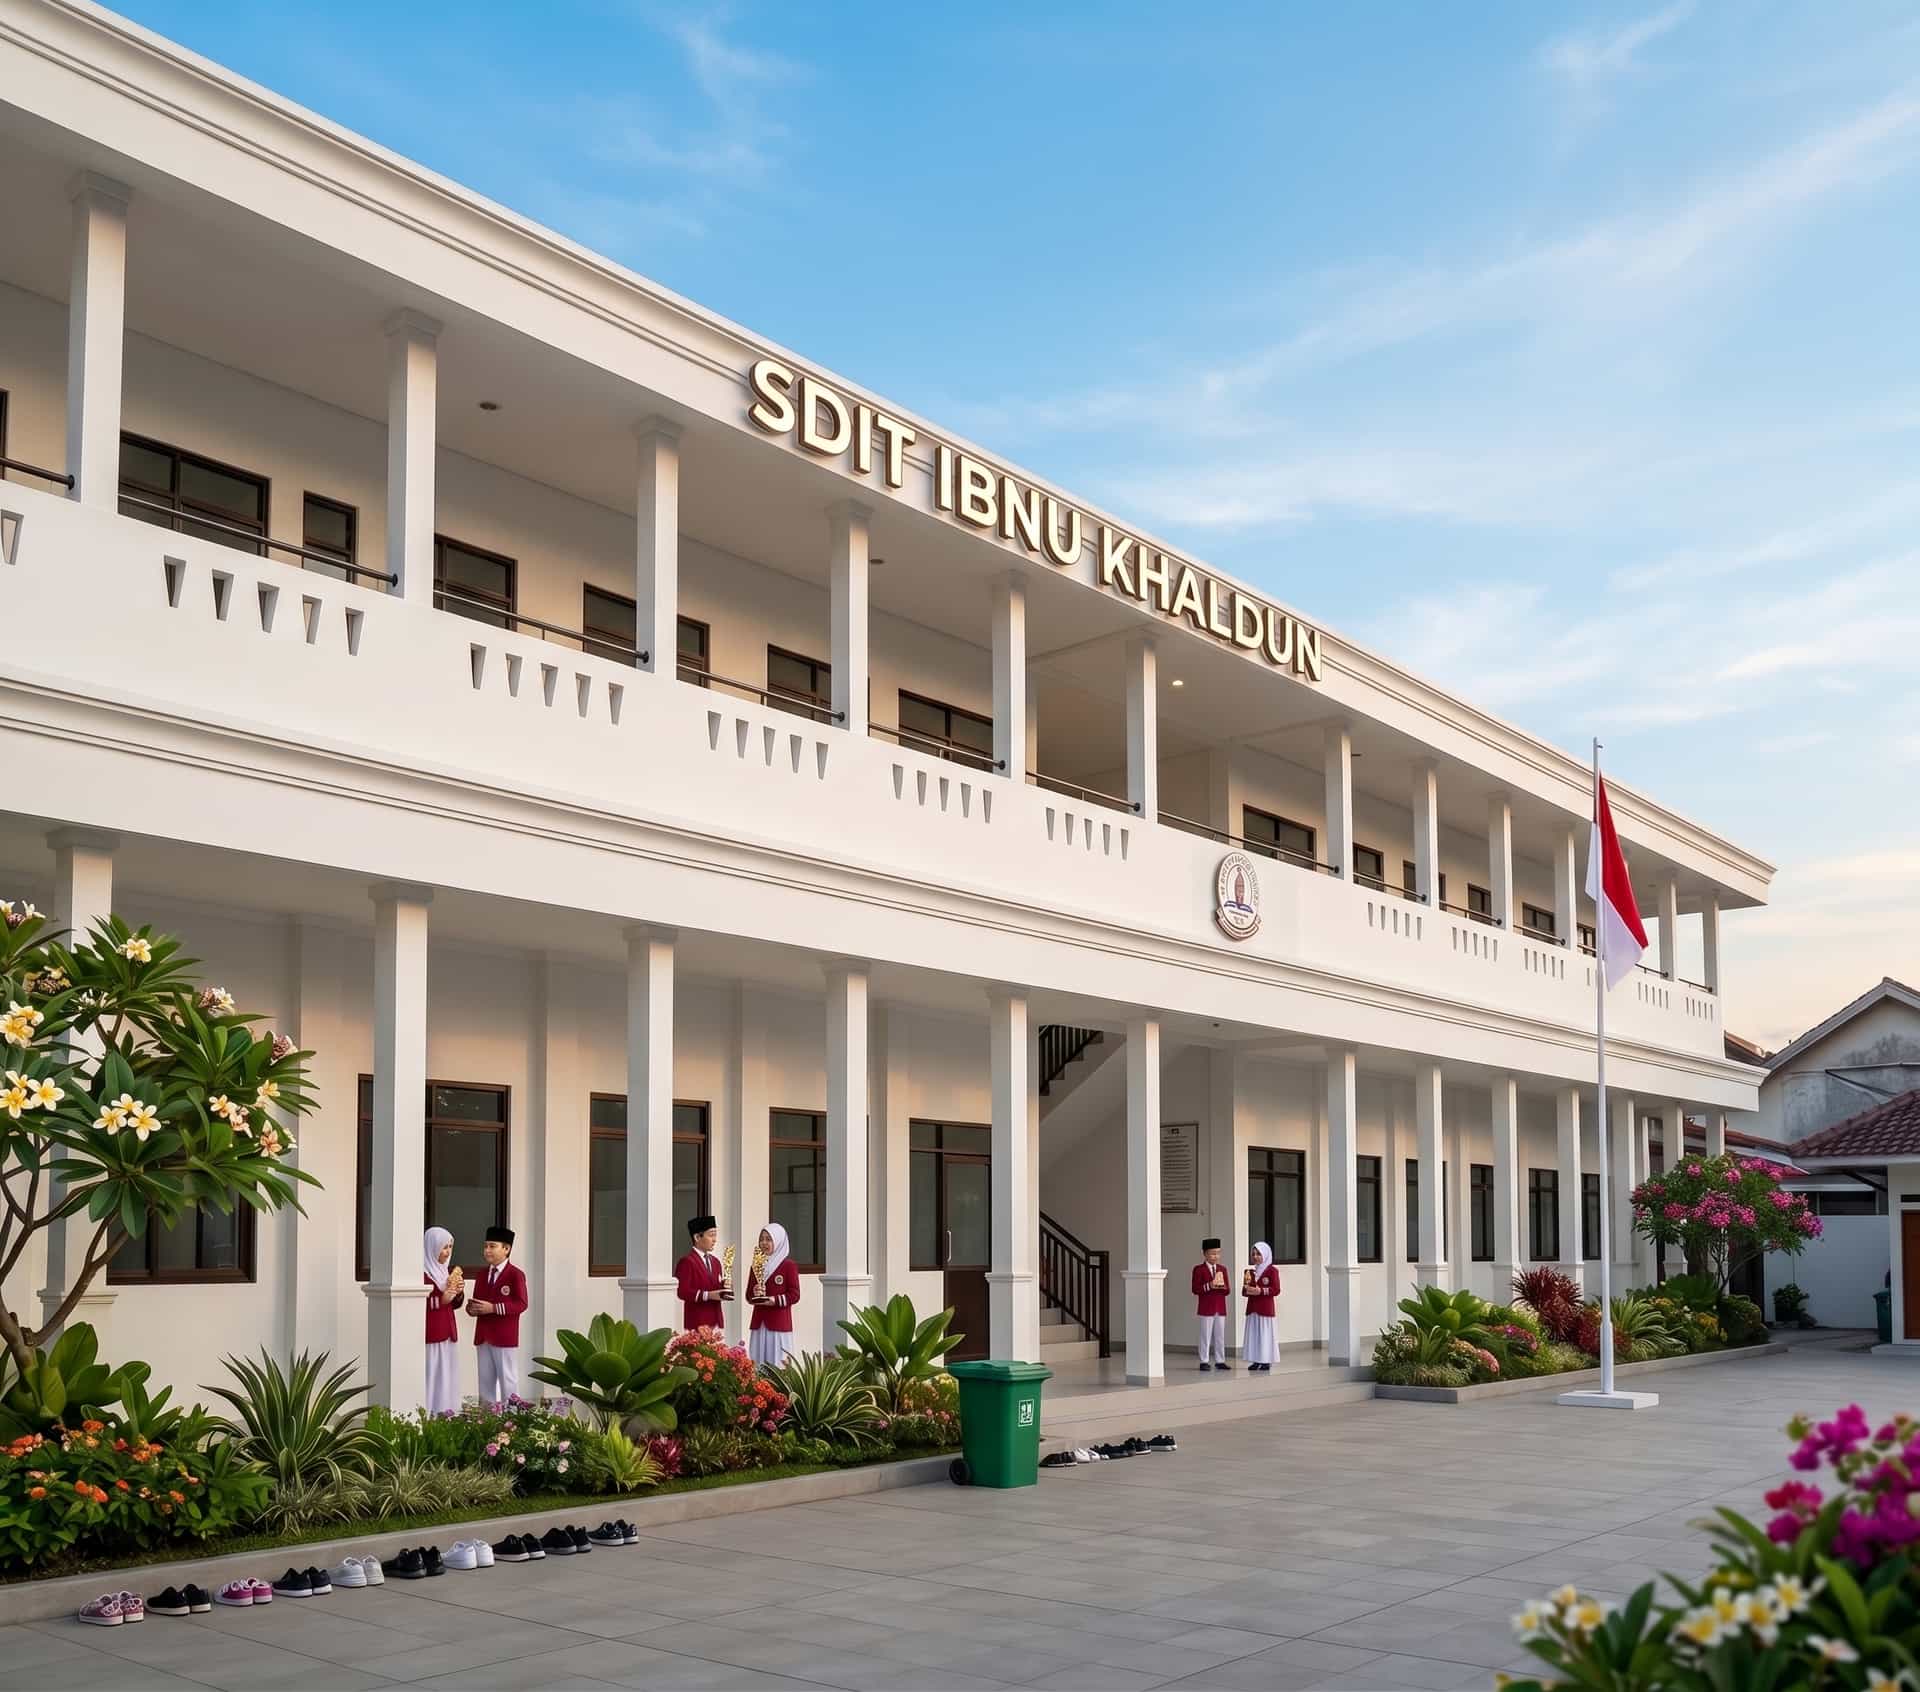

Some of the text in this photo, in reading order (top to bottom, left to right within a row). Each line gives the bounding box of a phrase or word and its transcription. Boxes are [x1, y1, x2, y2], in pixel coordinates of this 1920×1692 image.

[748, 360, 1321, 681] SDIT IBNU KHALDUN
